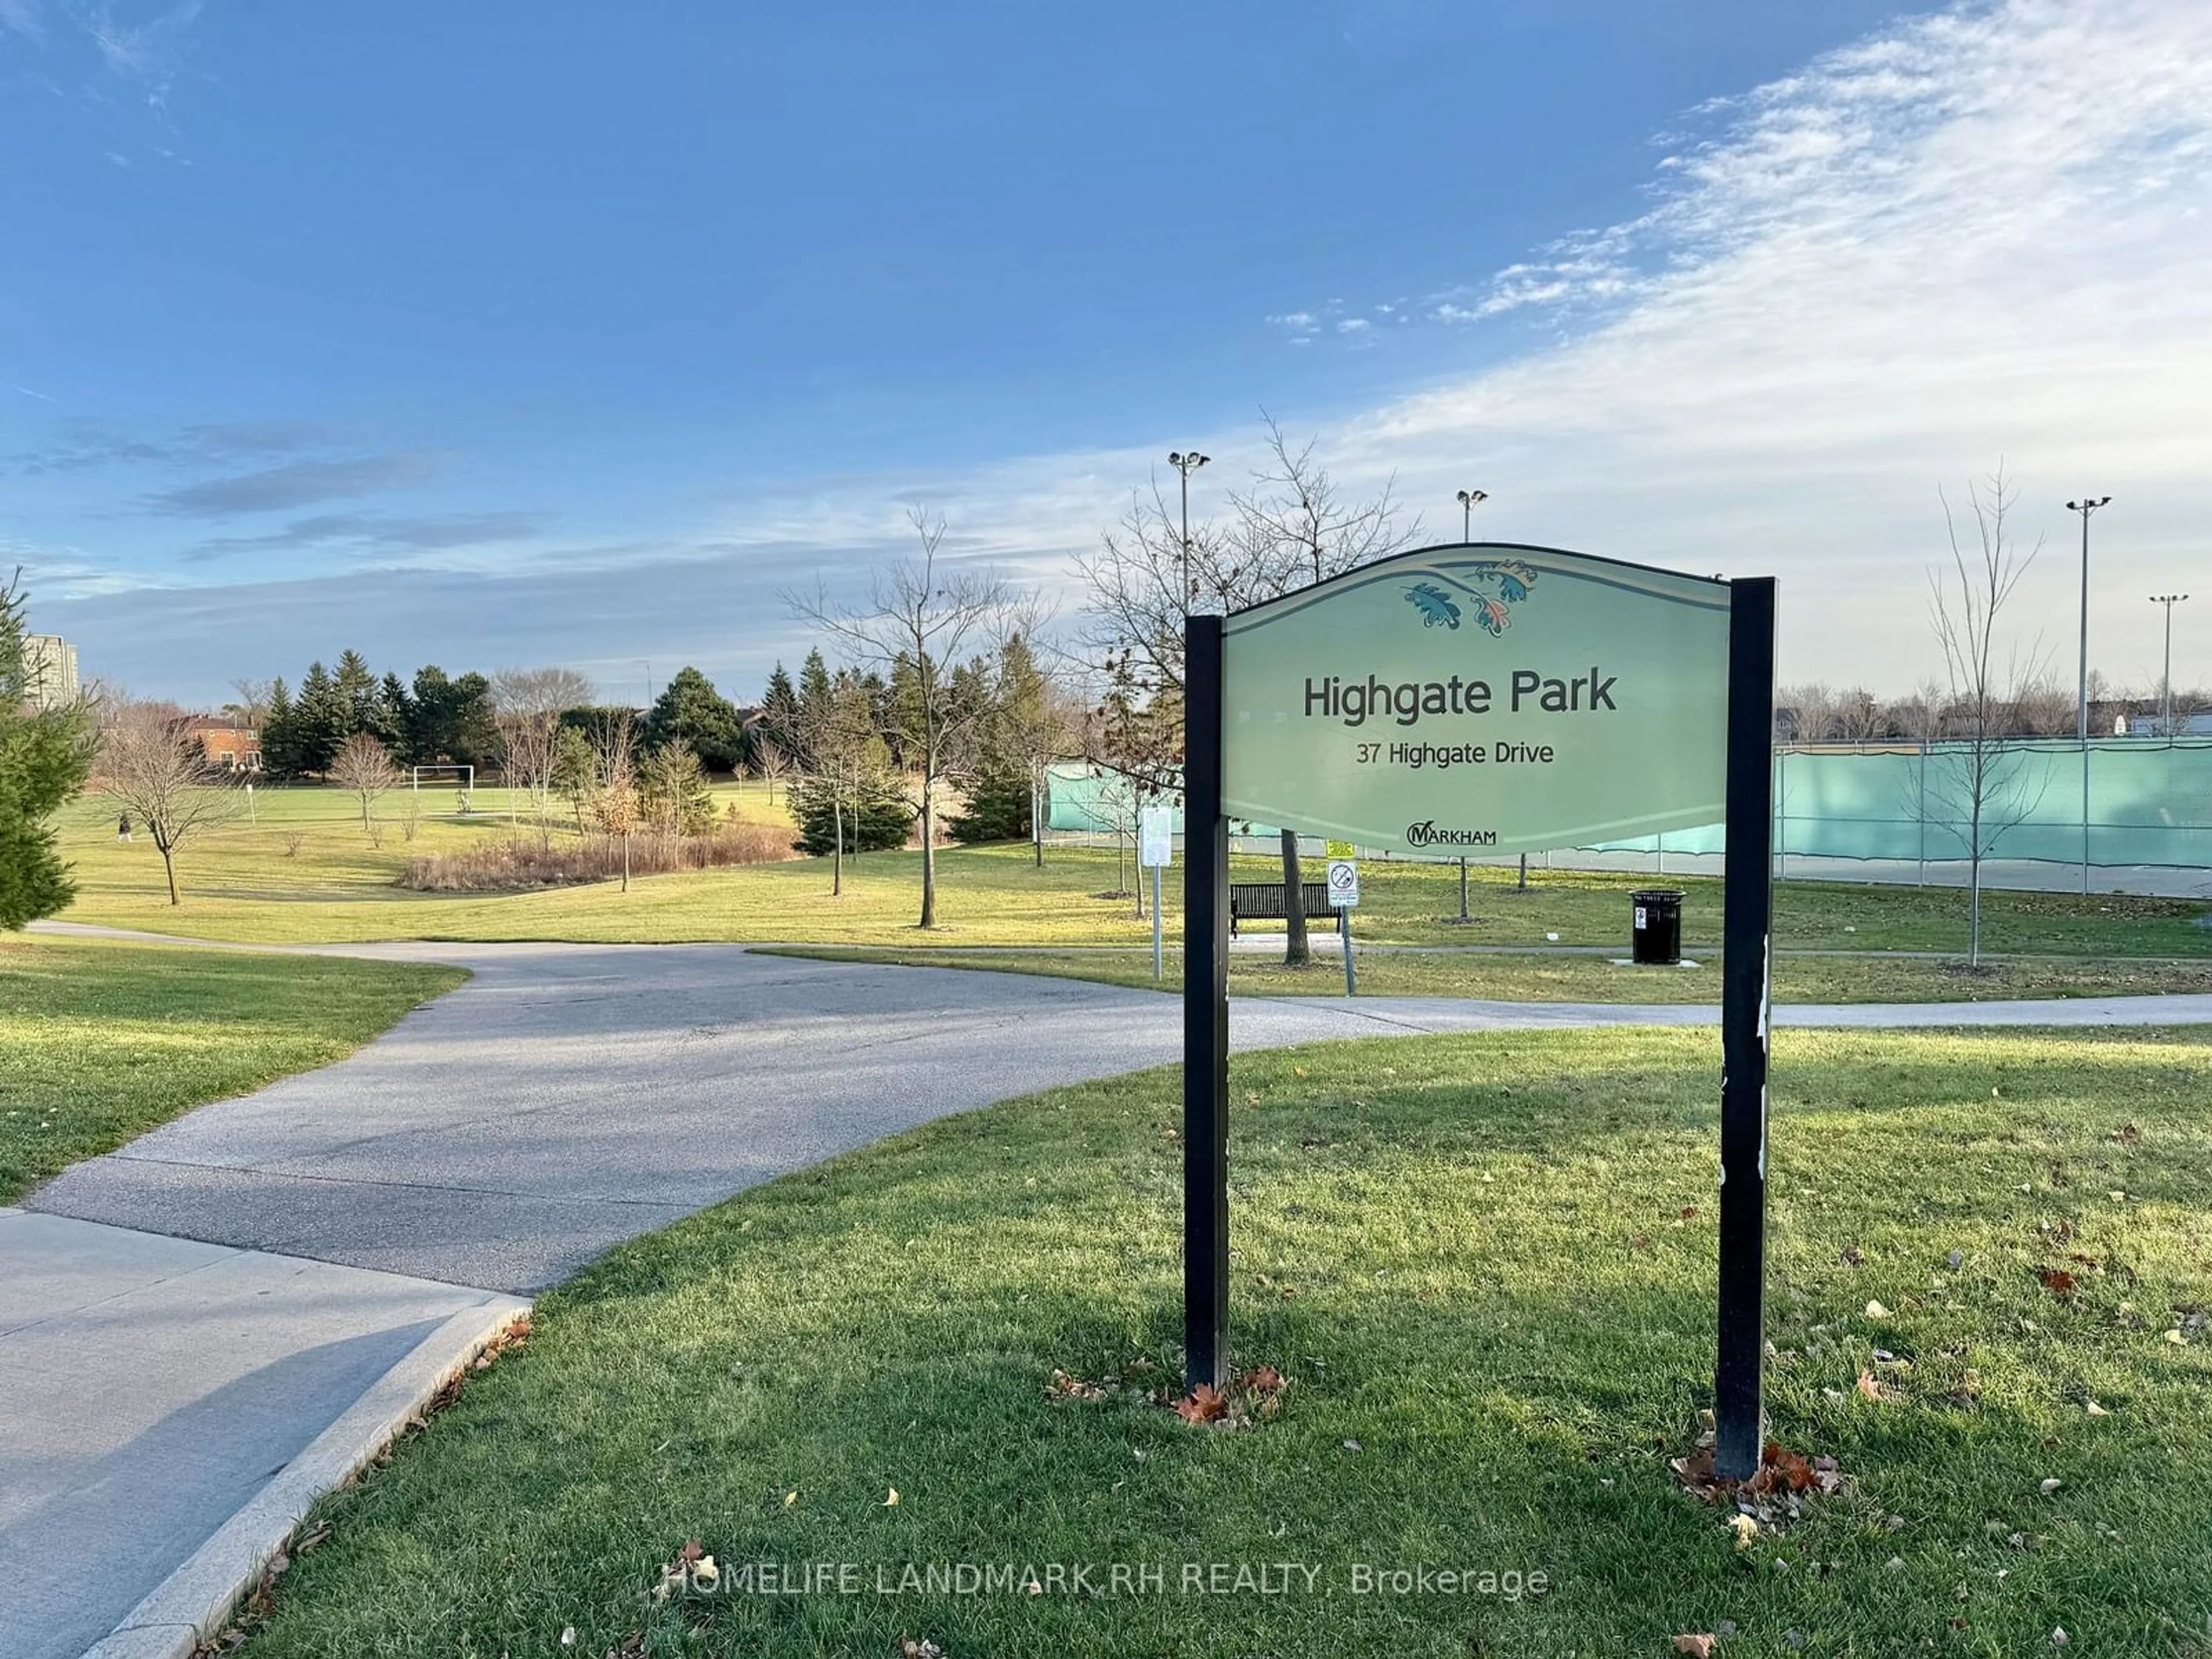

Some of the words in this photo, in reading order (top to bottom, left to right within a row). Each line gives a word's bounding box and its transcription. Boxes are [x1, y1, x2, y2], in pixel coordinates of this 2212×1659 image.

[1305, 674, 1491, 727] Highgate
[1511, 666, 1619, 713] Park
[1357, 743, 1382, 764] 37
[1389, 741, 1486, 770] Highgate
[1495, 741, 1554, 764] Drive
[1407, 820, 1497, 847] MARKHAM
